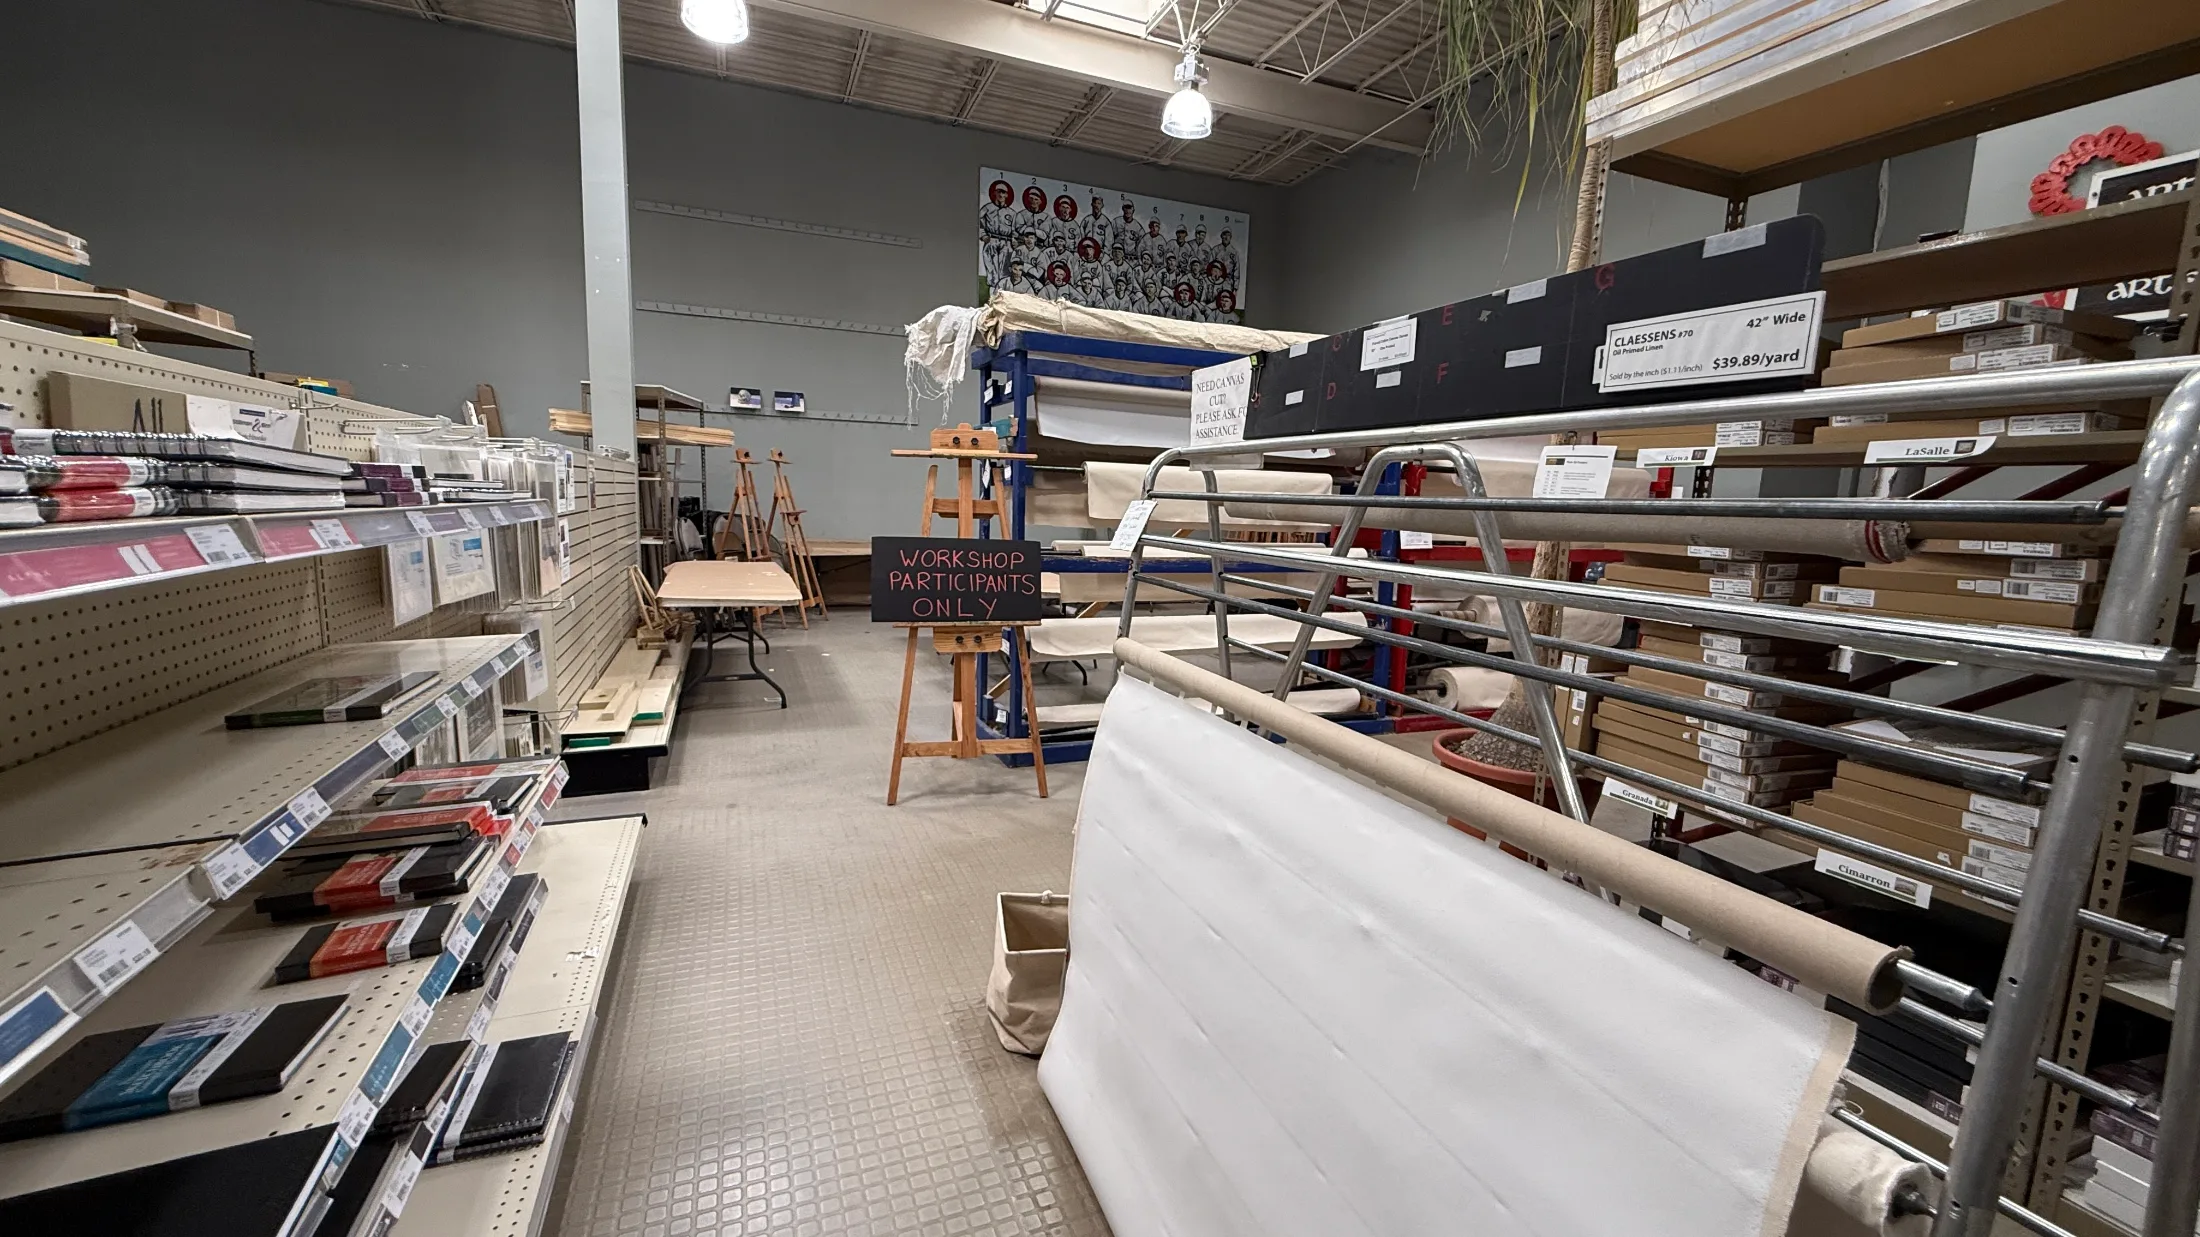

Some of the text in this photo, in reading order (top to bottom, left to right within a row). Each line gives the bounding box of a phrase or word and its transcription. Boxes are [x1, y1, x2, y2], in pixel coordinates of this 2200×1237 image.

[1088, 187, 1094, 195] 4
[1153, 206, 1158, 214] 6
[1180, 213, 1185, 221] 7
[1200, 213, 1205, 221] 8
[1224, 215, 1230, 223] 9
[1594, 263, 1615, 290] G
[1441, 304, 1454, 326] E
[1773, 311, 1806, 325] Wide
[1332, 334, 1343, 352] C
[1614, 329, 1694, 348] CLAESSENS #70
[1622, 346, 1645, 356] Primed
[1645, 343, 1664, 352] Linen
[1712, 349, 1800, 371] $39.89/yard
[1437, 361, 1449, 384] F
[1609, 372, 1623, 381] Sold
[1624, 371, 1632, 380] by
[1633, 370, 1644, 378] the
[1645, 368, 1660, 377] inch
[1196, 372, 1245, 394] NEED CANVAS
[1327, 382, 1337, 400] D
[1209, 393, 1227, 406] CUT?
[1195, 410, 1221, 424] PLEASE
[1221, 409, 1236, 420] ASK
[1664, 454, 1689, 462] Kiowa
[1904, 446, 1950, 456] LaSalle
[900, 549, 1025, 569] WORKSHOP
[889, 571, 1035, 595] PARTICIPANTS
[912, 598, 997, 619] ONLY
[1622, 789, 1653, 805] Granada
[1838, 864, 1891, 889] Cimarron
